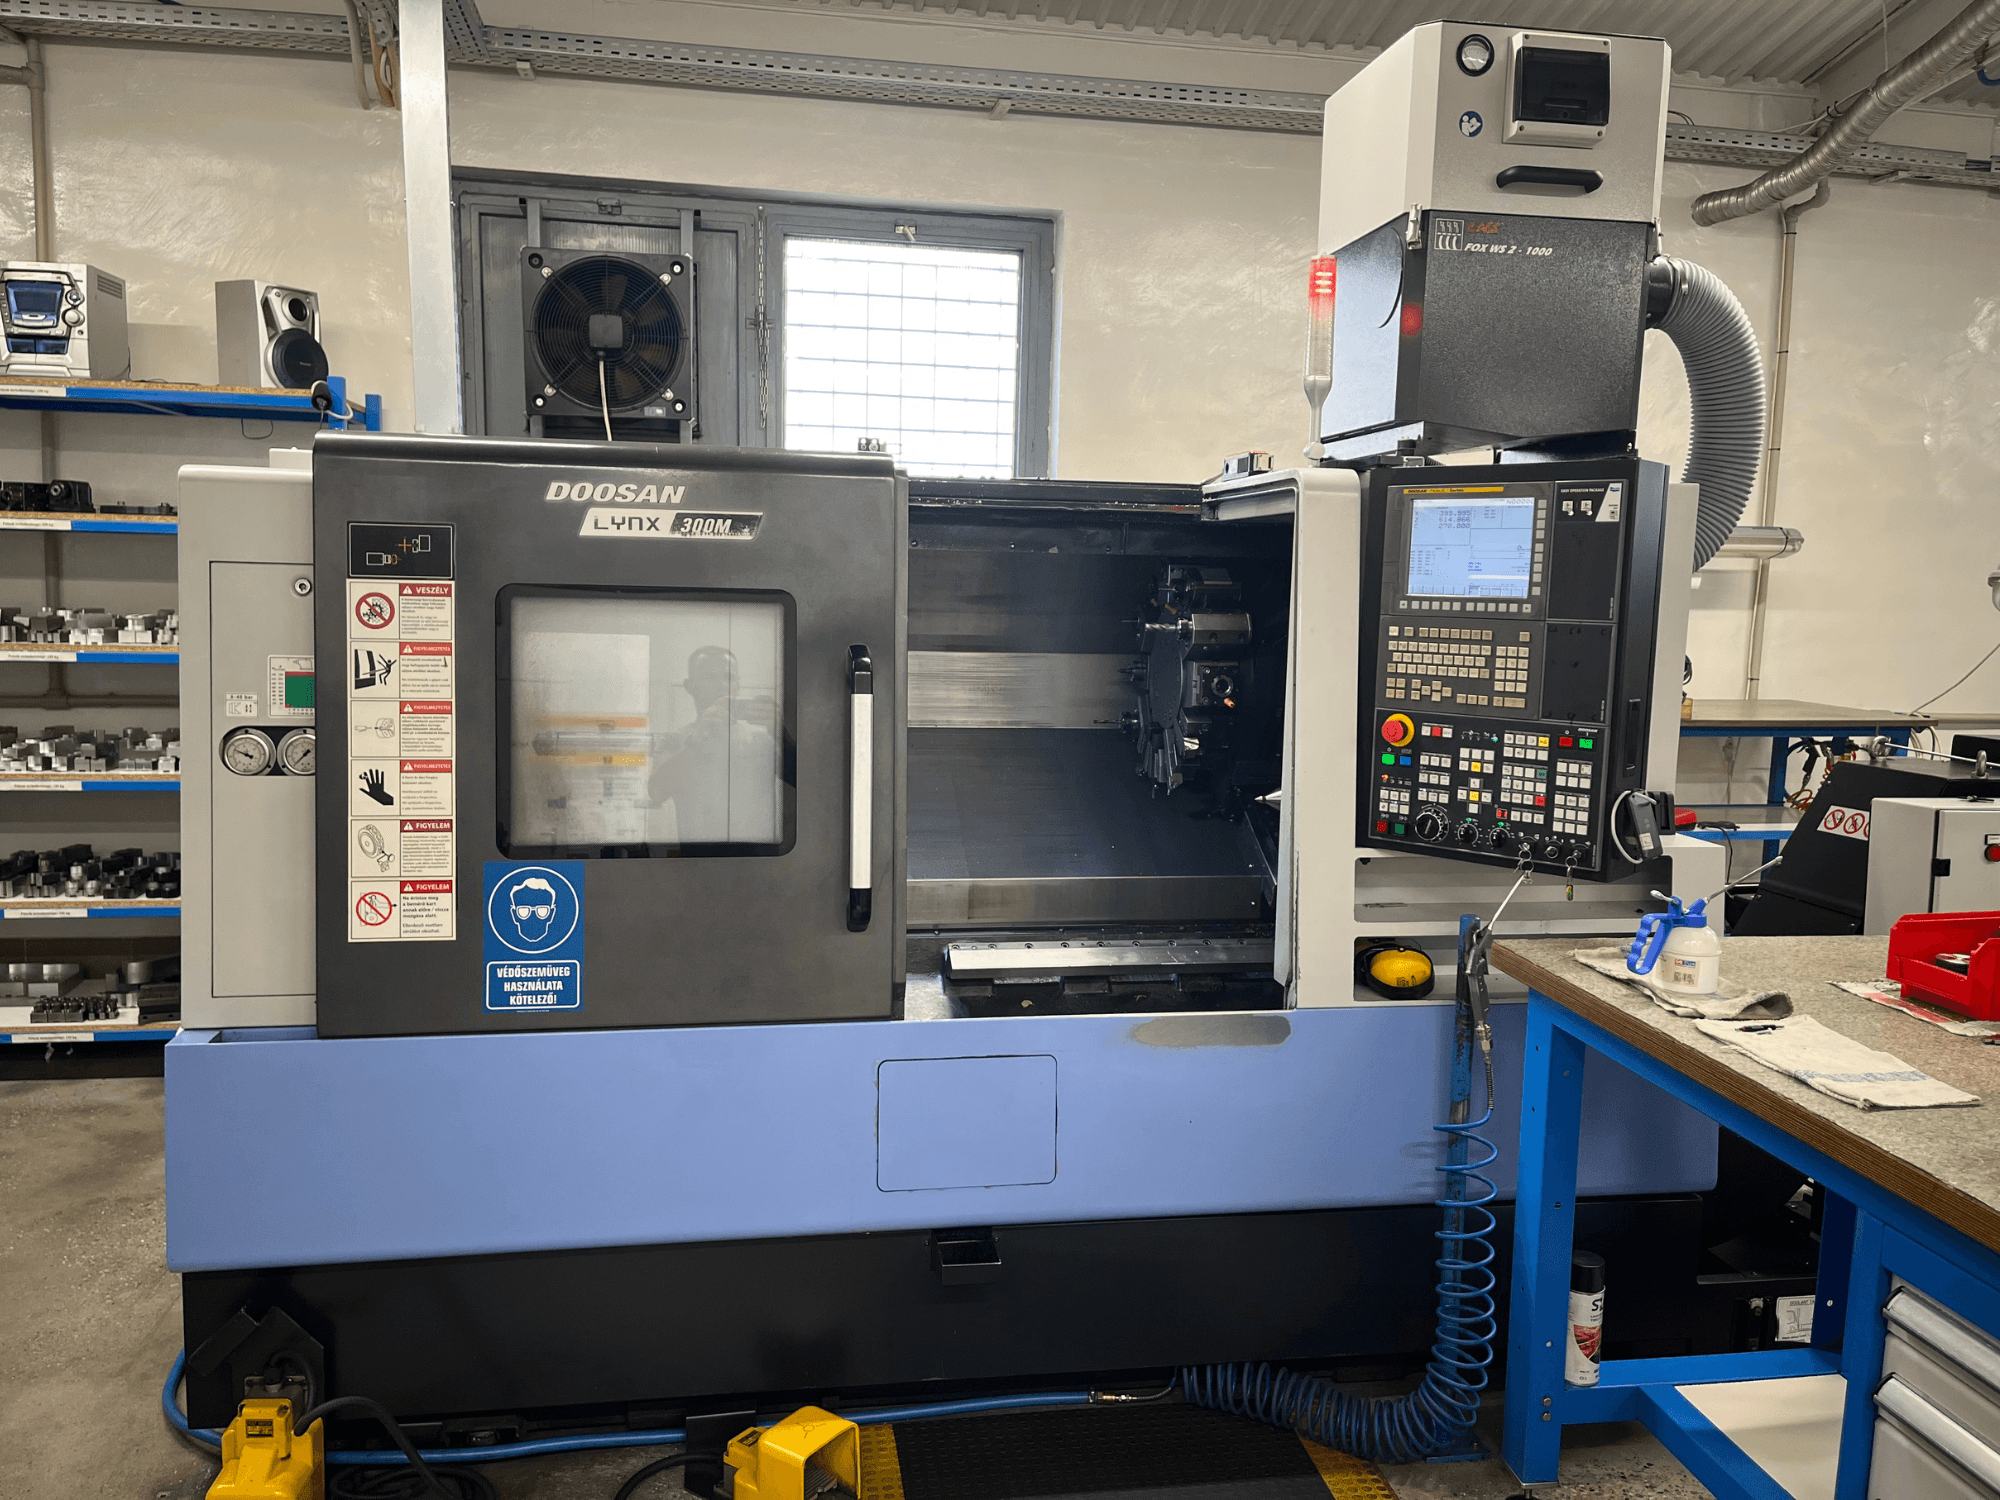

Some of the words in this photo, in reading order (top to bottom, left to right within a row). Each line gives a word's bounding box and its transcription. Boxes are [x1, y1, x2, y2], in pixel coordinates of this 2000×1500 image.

[1464, 242, 1489, 253] FOX
[1489, 244, 1508, 254] WS
[1507, 245, 1518, 255] 2
[1526, 246, 1553, 256] 1000
[545, 481, 686, 504] DOOSAN
[593, 515, 661, 532] LYNX
[680, 517, 733, 534] 300M
[415, 585, 449, 595] VESZÉLY
[416, 883, 450, 891] FIGYELEM
[496, 964, 571, 978] VÉDŐSZEMÜVEG
[503, 978, 564, 992] HASZNÁLATA
[509, 992, 557, 1006] KÖTELEZŐ!
